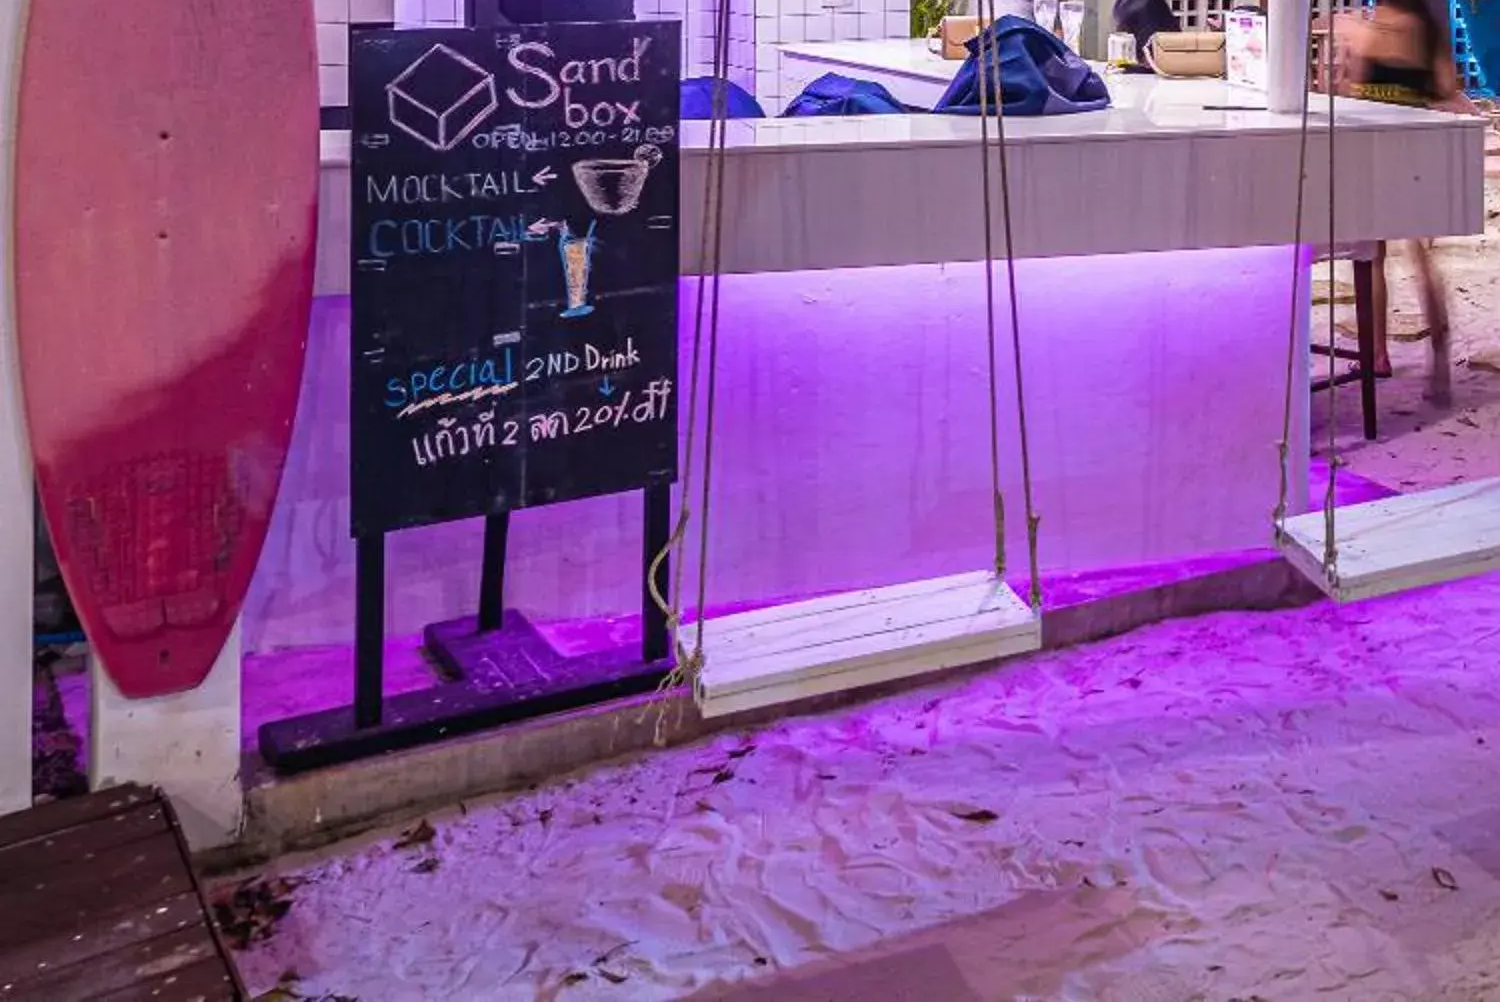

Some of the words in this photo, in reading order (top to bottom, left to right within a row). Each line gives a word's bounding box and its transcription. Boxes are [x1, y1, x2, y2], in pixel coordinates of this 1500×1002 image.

[506, 37, 652, 109] Sand
[563, 87, 641, 129] box
[366, 170, 538, 204] MOCKTAIL
[369, 213, 548, 258] COCKTAIL
[525, 353, 579, 382] 2ND
[584, 337, 641, 371] Drink
